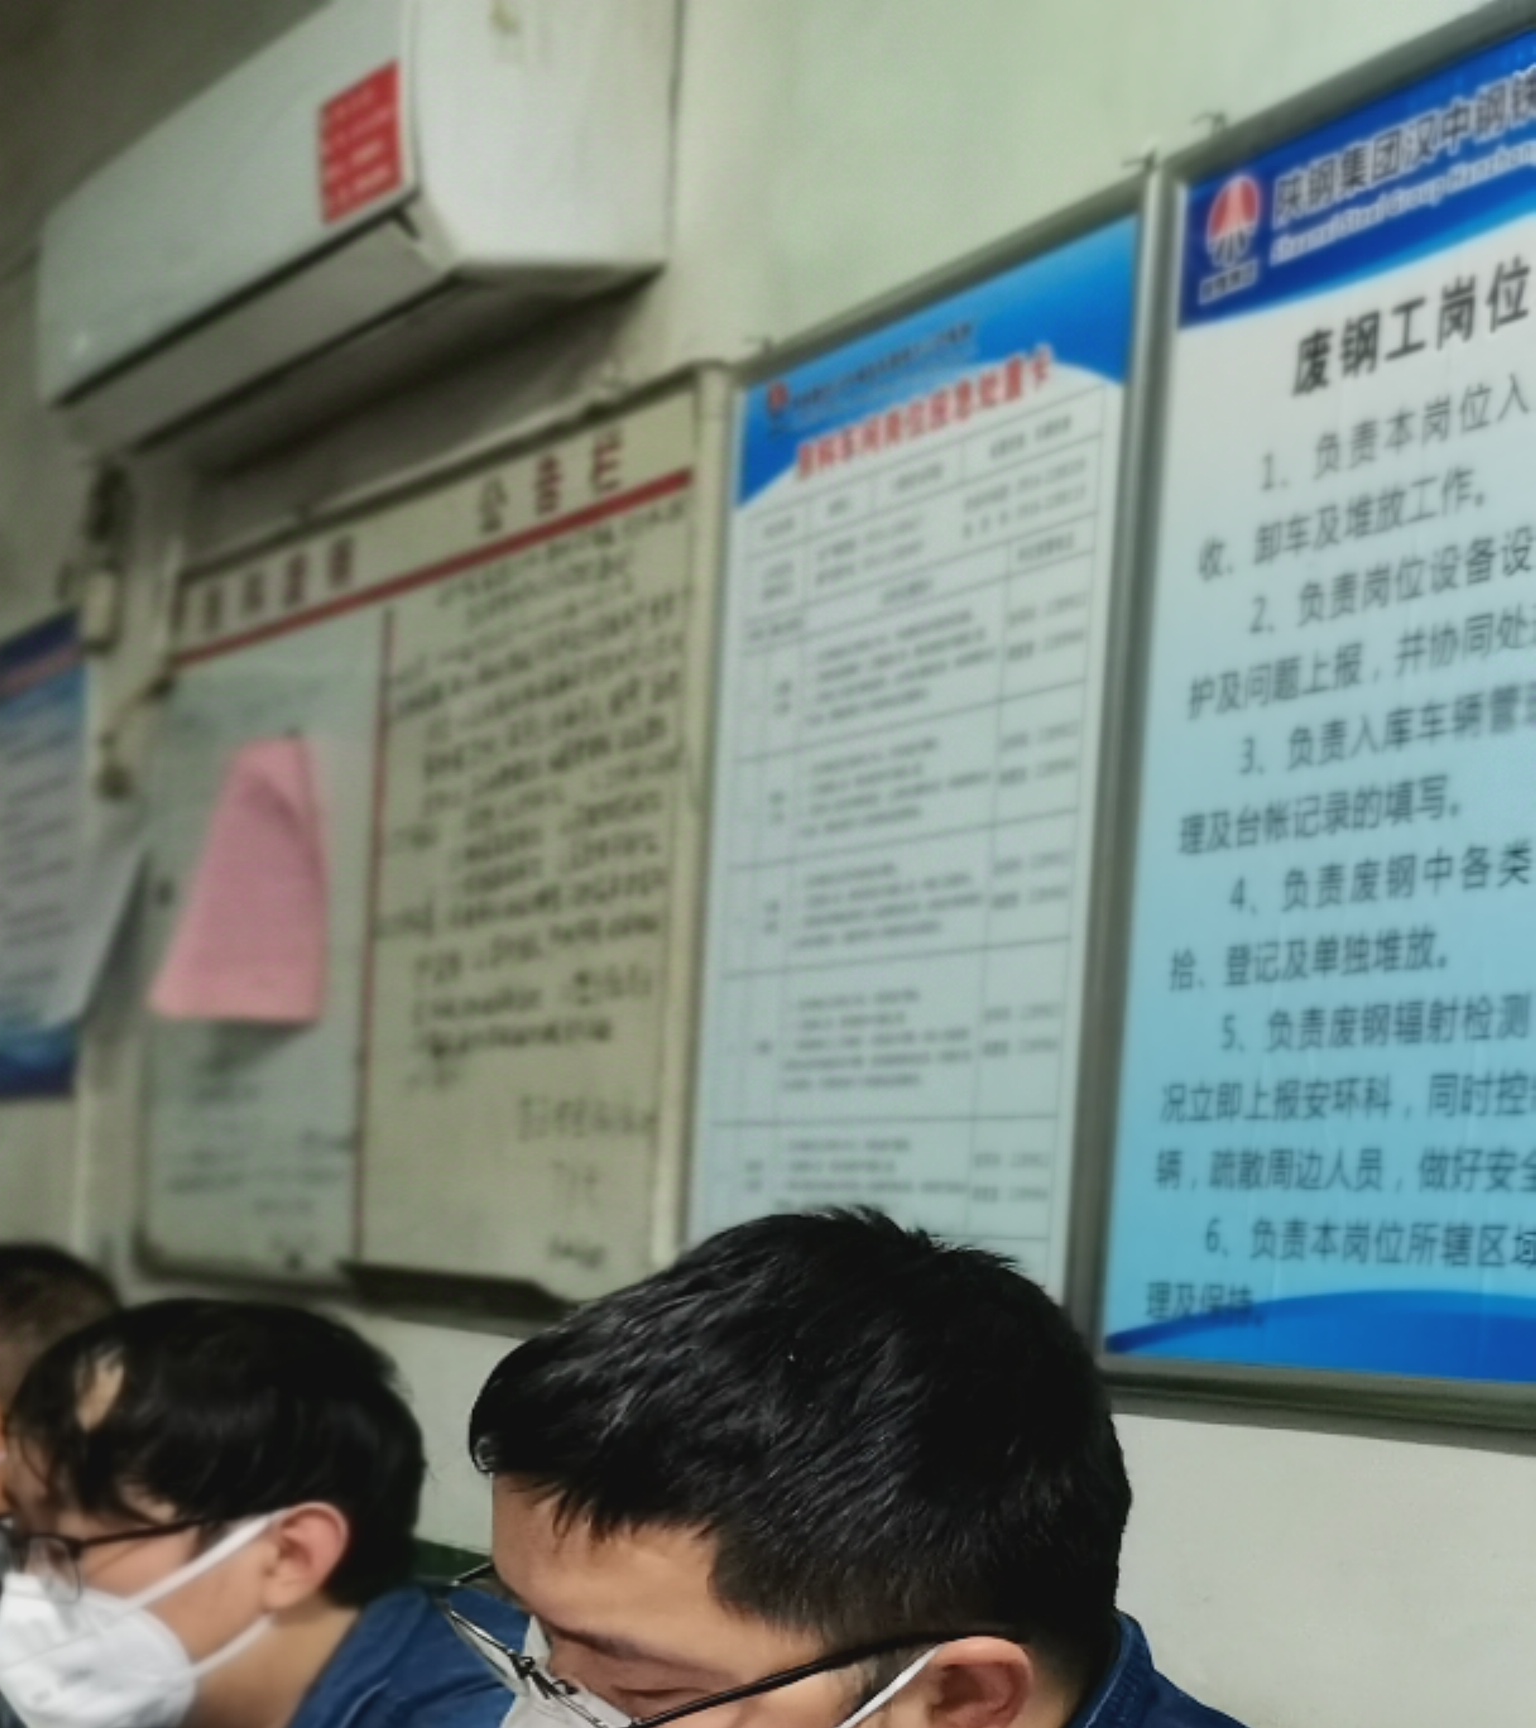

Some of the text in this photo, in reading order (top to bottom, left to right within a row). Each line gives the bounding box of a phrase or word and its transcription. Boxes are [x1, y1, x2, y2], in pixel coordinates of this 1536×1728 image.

[1292, 255, 1530, 397] 废钢工岗位
